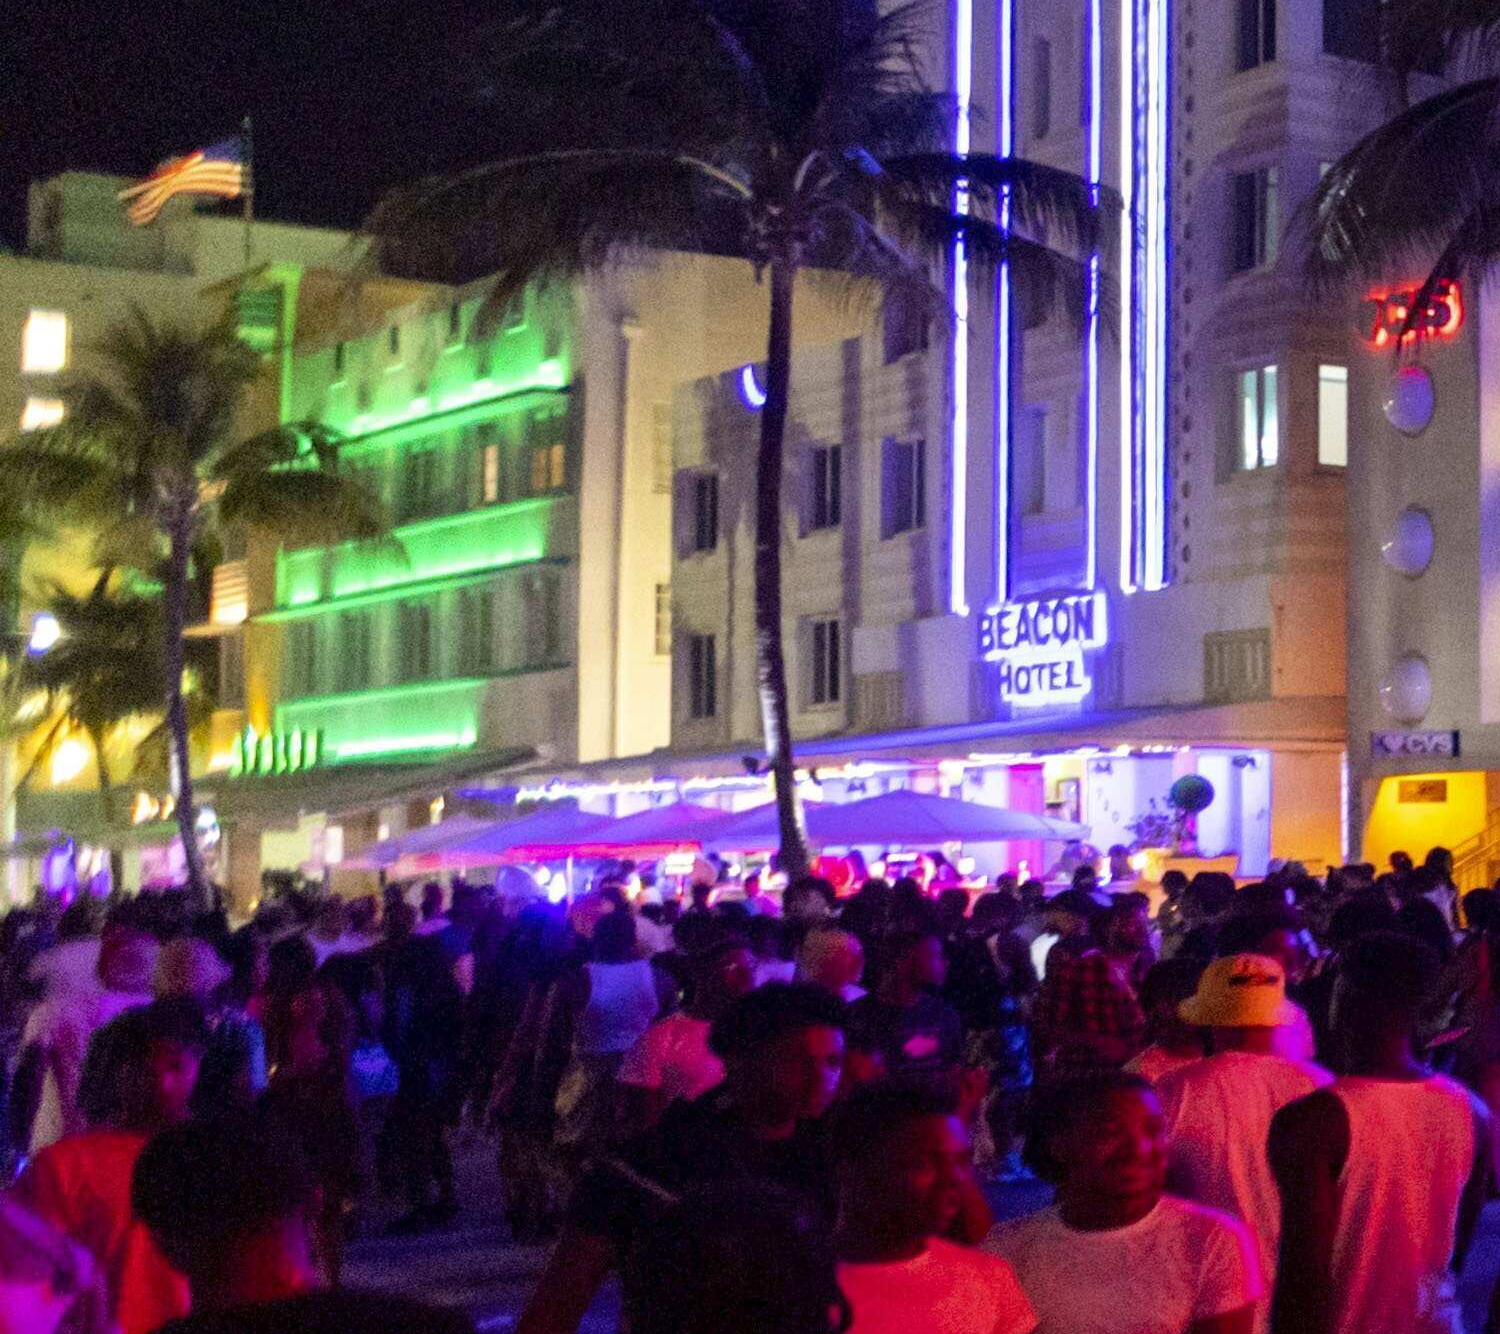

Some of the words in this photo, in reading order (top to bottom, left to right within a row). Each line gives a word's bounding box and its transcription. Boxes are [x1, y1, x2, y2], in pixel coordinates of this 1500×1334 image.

[977, 597, 1095, 654] BEACON
[998, 659, 1083, 696] HOTEL
[1406, 734, 1454, 755] CVS
